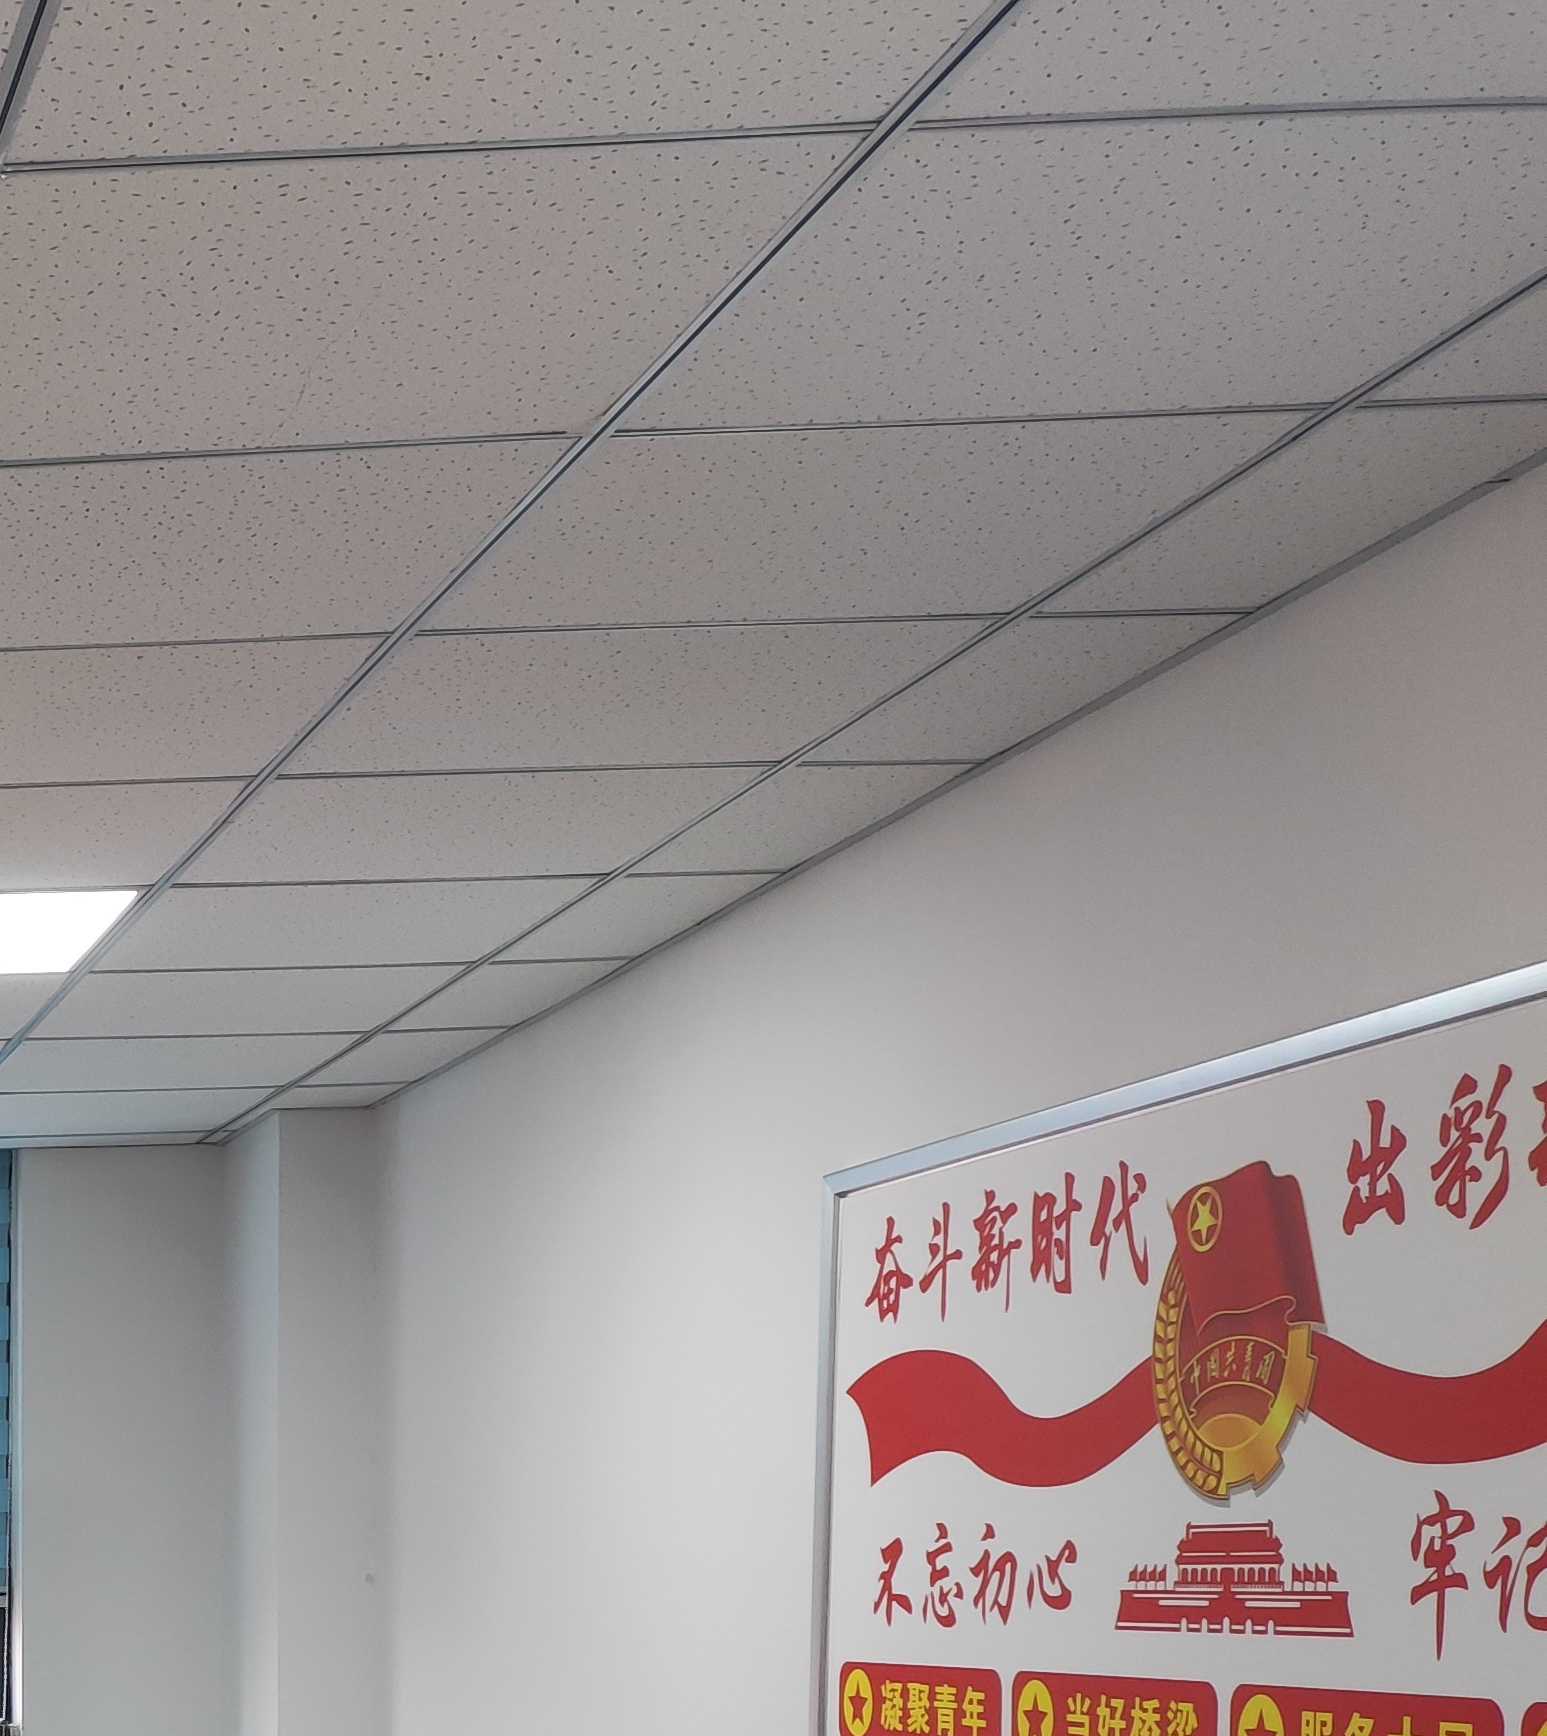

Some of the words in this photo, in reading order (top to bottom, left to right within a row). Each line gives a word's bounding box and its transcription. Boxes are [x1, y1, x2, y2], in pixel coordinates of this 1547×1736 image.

[864, 1160, 1149, 1324] 奋斗新时代
[873, 1522, 1078, 1628] 不忘初心
